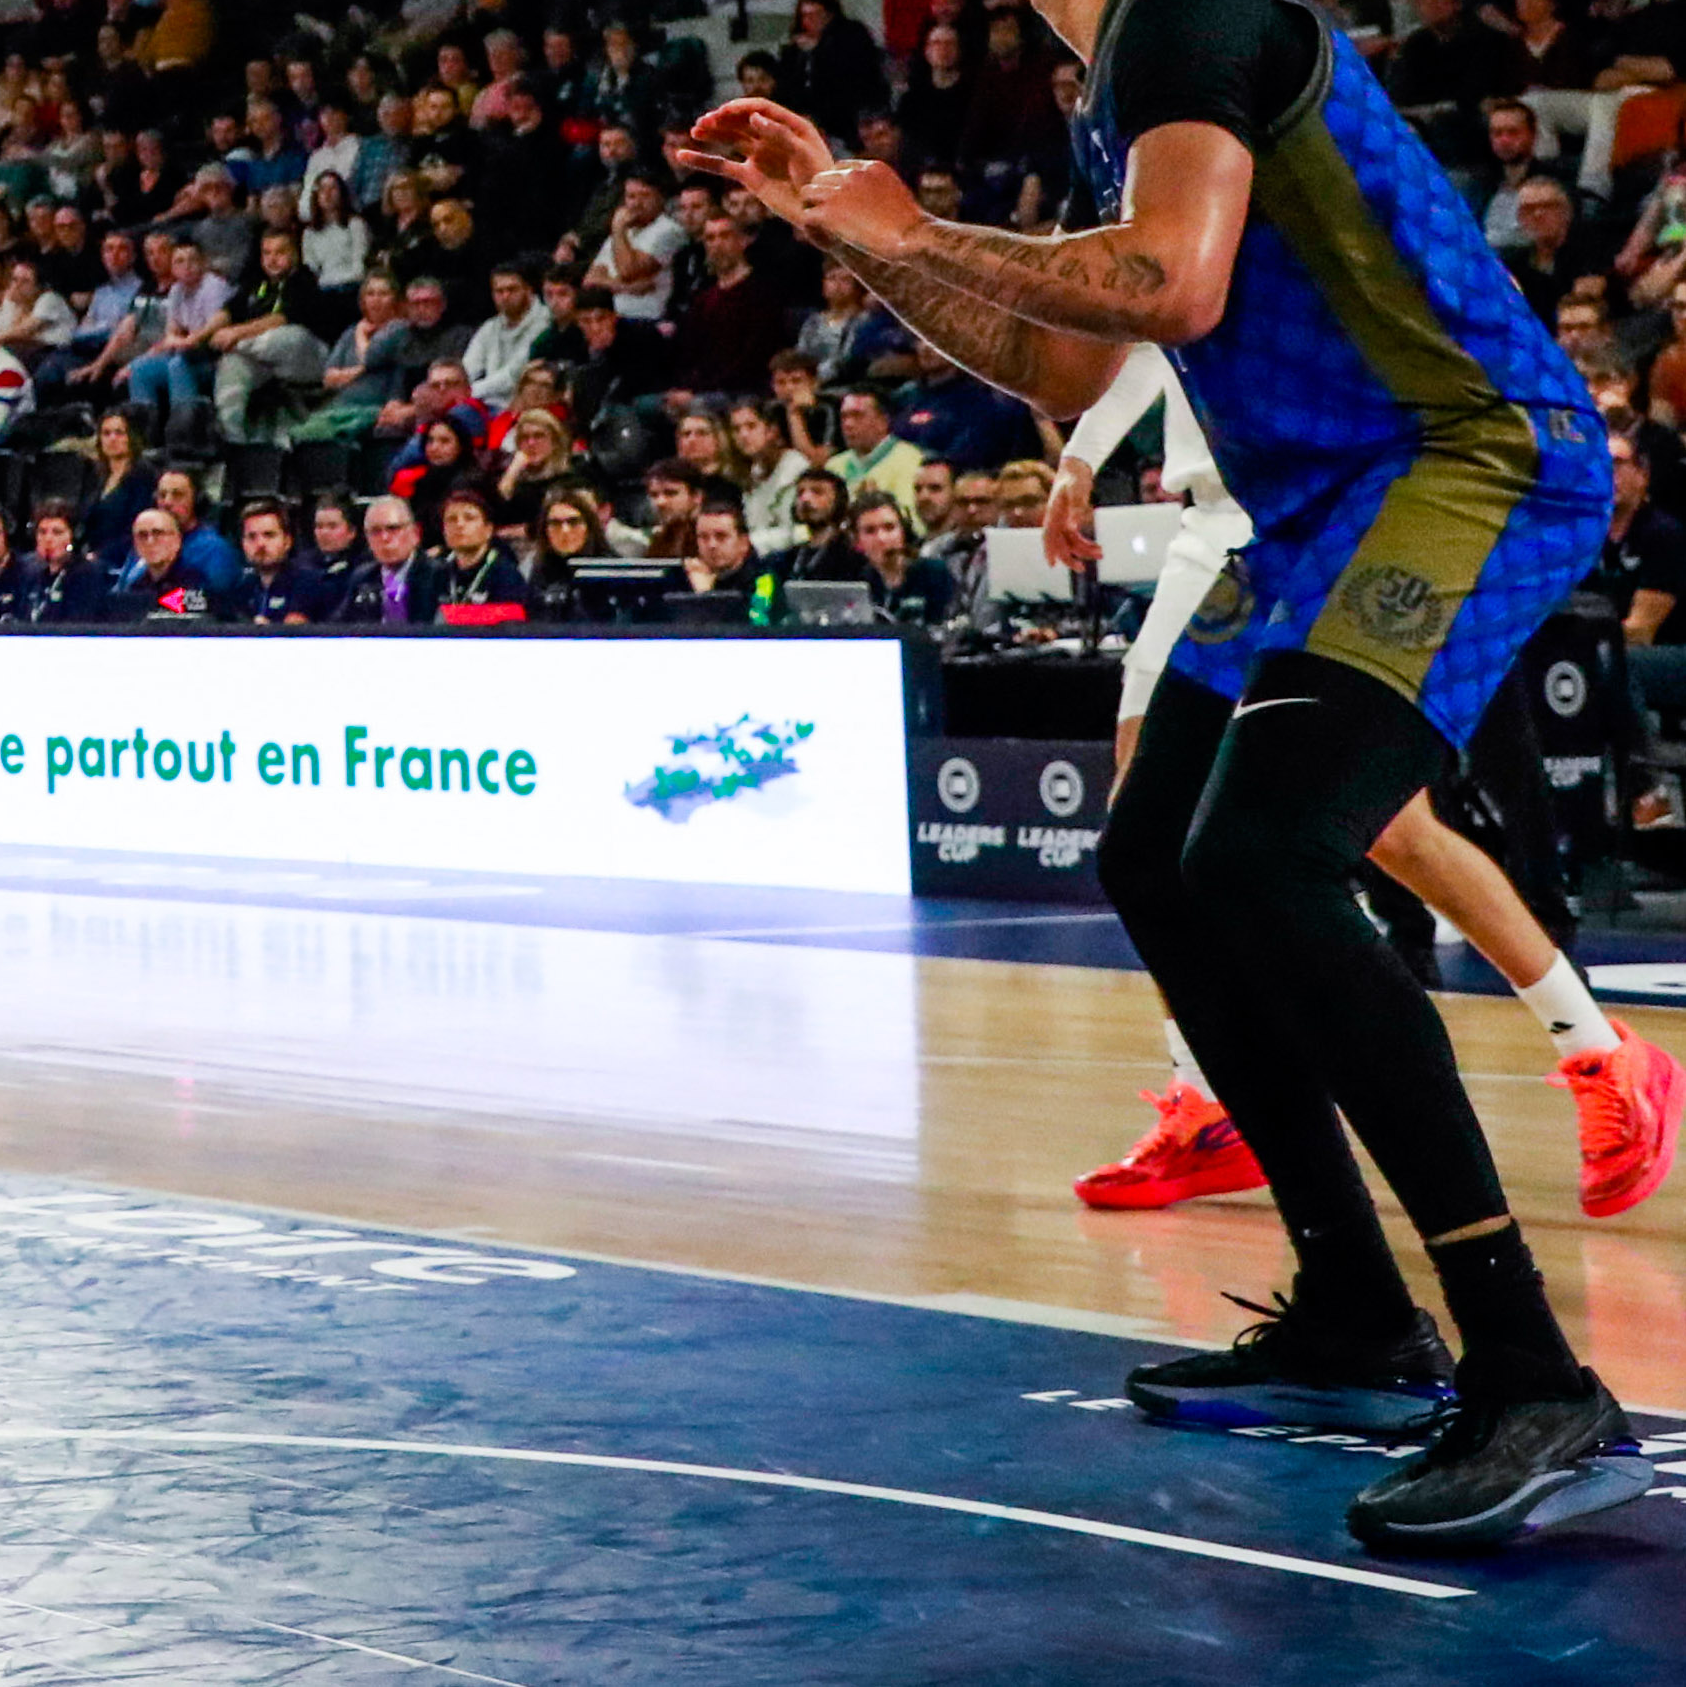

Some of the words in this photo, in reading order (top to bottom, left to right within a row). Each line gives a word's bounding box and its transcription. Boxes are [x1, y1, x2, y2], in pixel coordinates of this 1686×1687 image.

[46, 727, 236, 795] partout
[257, 742, 320, 786] en
[345, 726, 537, 796] France
[916, 821, 1006, 847] LEADERS
[938, 843, 979, 863] CUP
